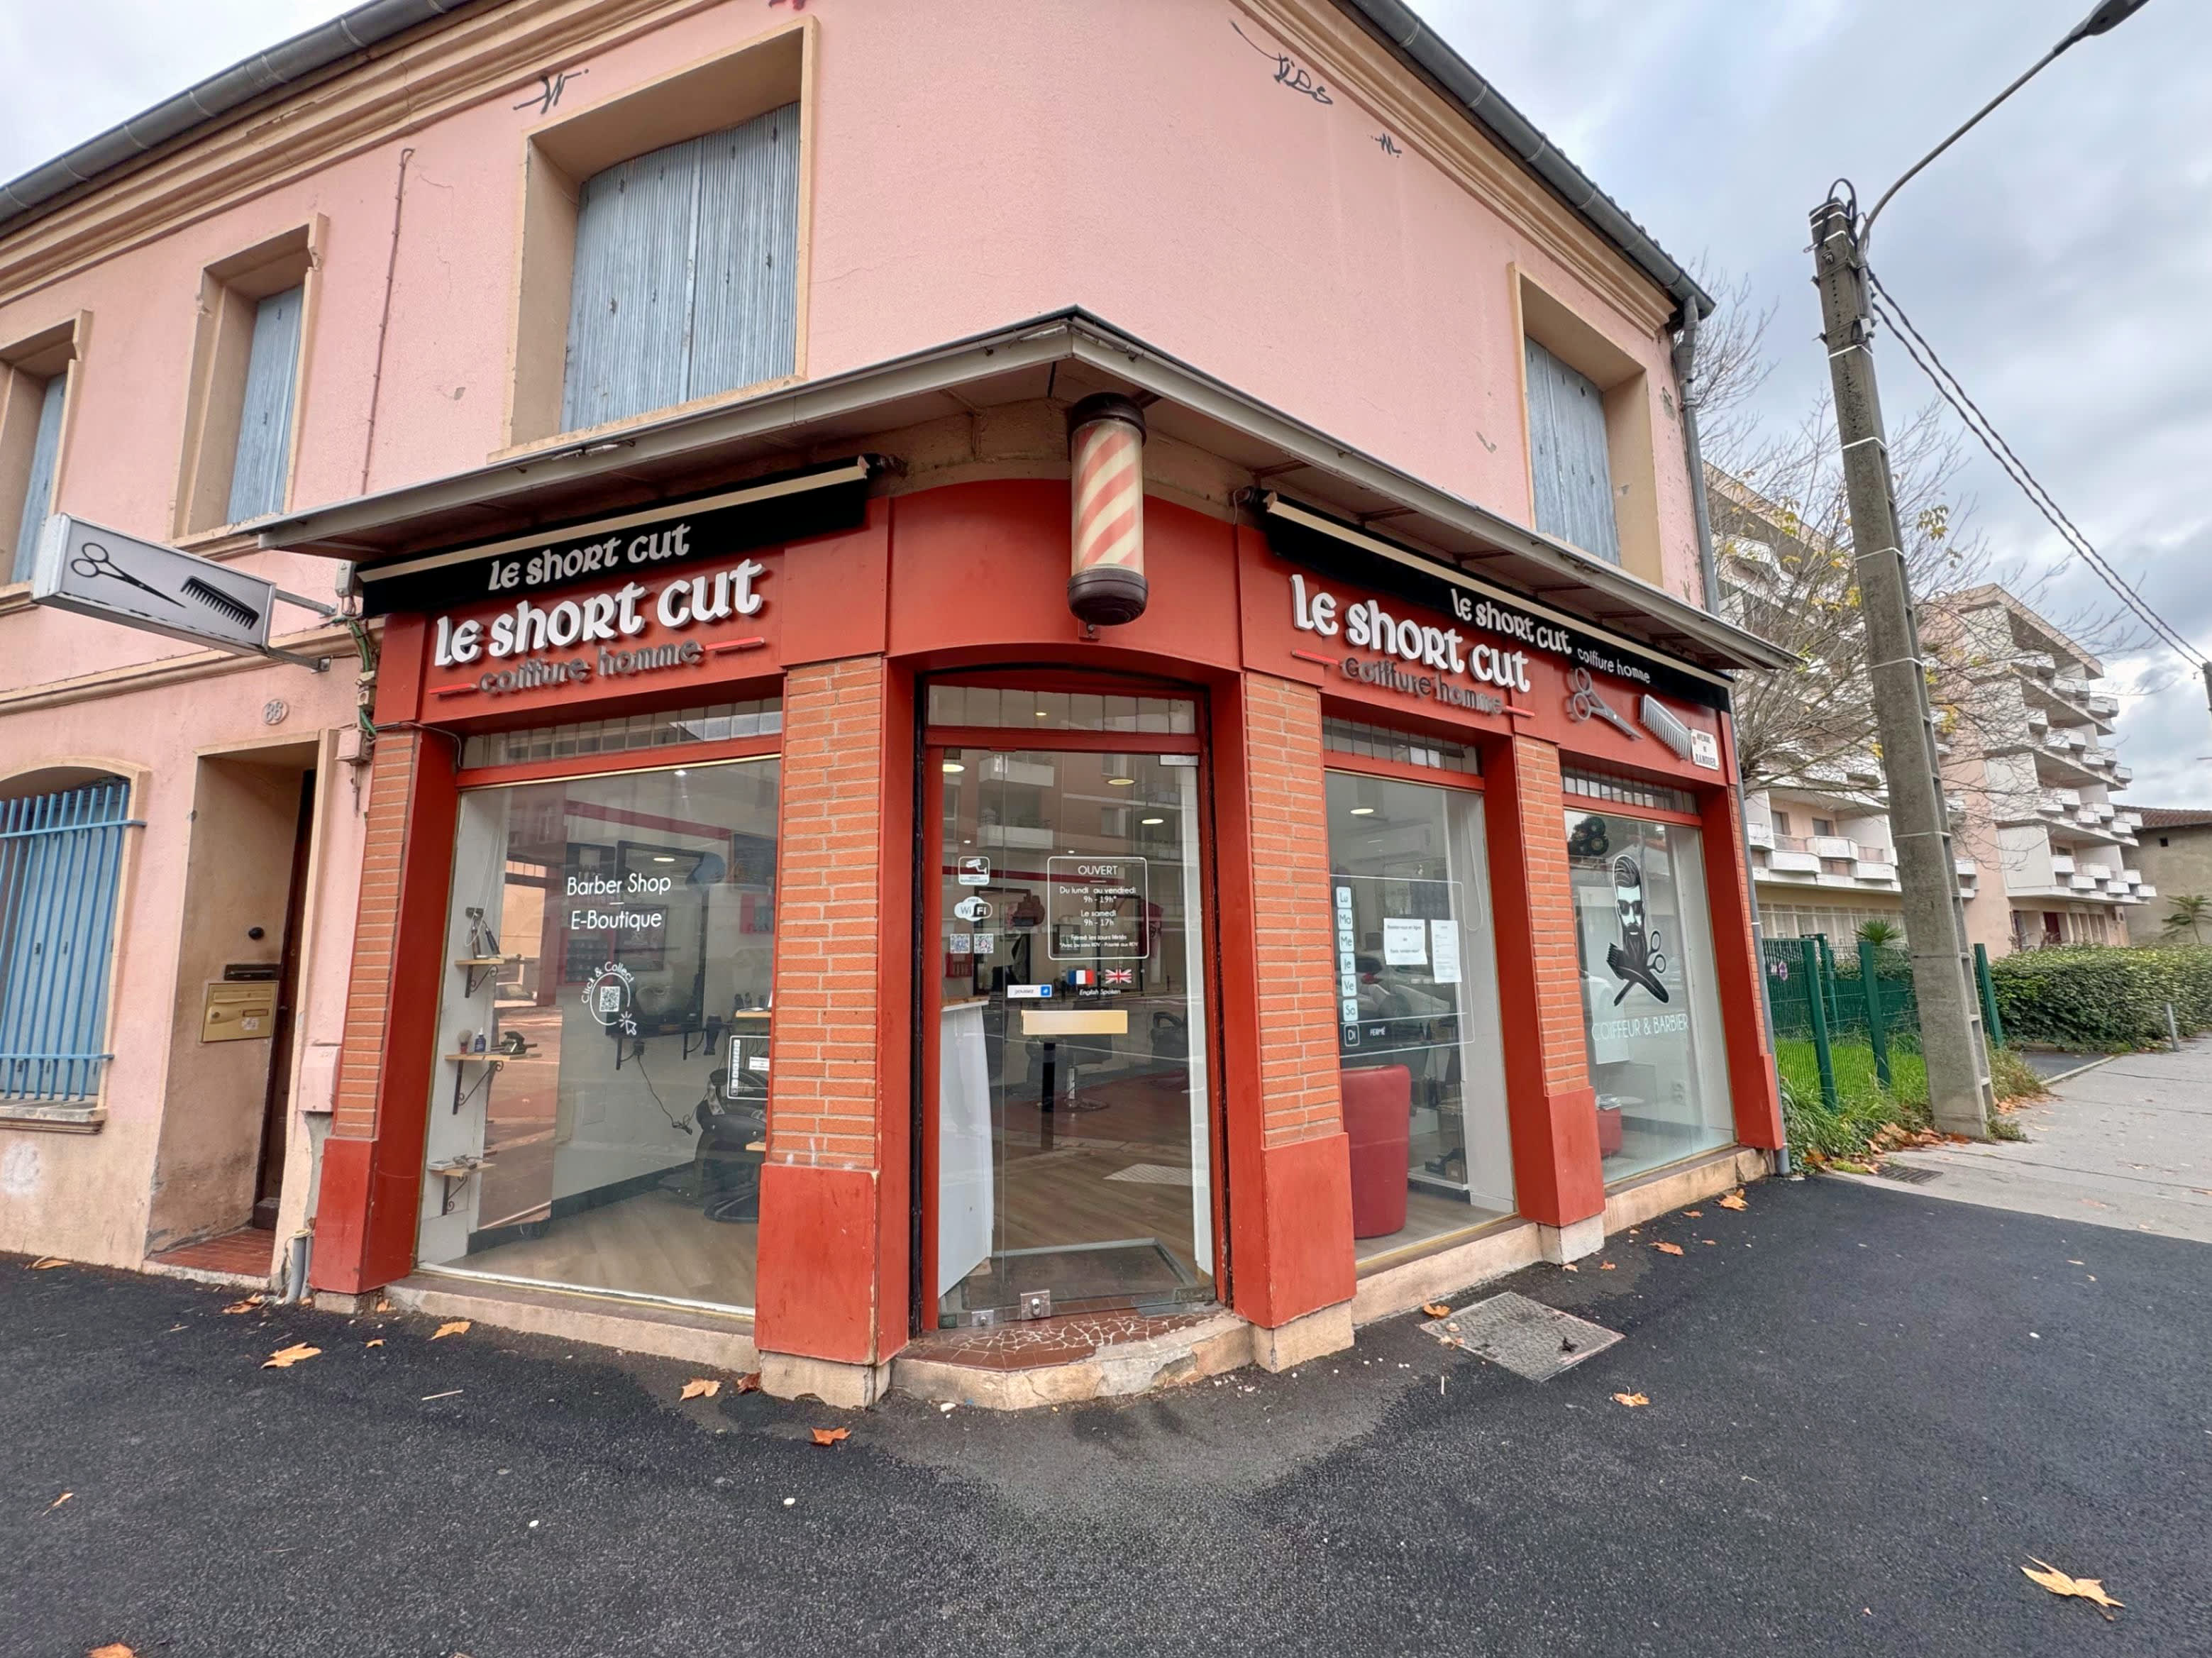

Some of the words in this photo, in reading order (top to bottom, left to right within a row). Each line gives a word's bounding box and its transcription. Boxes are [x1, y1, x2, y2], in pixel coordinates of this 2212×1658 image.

[488, 560, 520, 590] le
[627, 523, 692, 563] cut
[434, 615, 485, 667] le
[657, 558, 765, 629] cut
[1451, 588, 1472, 621] le
[1537, 626, 1572, 654] cut
[1290, 574, 1339, 636] le
[1469, 643, 1531, 693] cut
[479, 657, 591, 693] coiffure
[597, 638, 704, 678] homme
[1577, 647, 1615, 673] coiffure
[1617, 659, 1651, 684] homme
[1342, 657, 1432, 697] coiffure
[1434, 674, 1503, 714] homme
[568, 875, 622, 895] Barber
[627, 873, 671, 895] Shop
[1078, 866, 1118, 875] OUVERT
[1339, 892, 1349, 902] Lu
[571, 910, 662, 932] E-Boutique
[1341, 936, 1352, 946] Me
[582, 978, 595, 1003] Click
[595, 967, 603, 977] &
[604, 961, 634, 983] Collect
[1344, 980, 1354, 991] Ve
[1591, 1018, 1641, 1041] COIFFEUR
[1644, 1017, 1652, 1036] &
[1653, 1013, 1688, 1034] BARBIER
